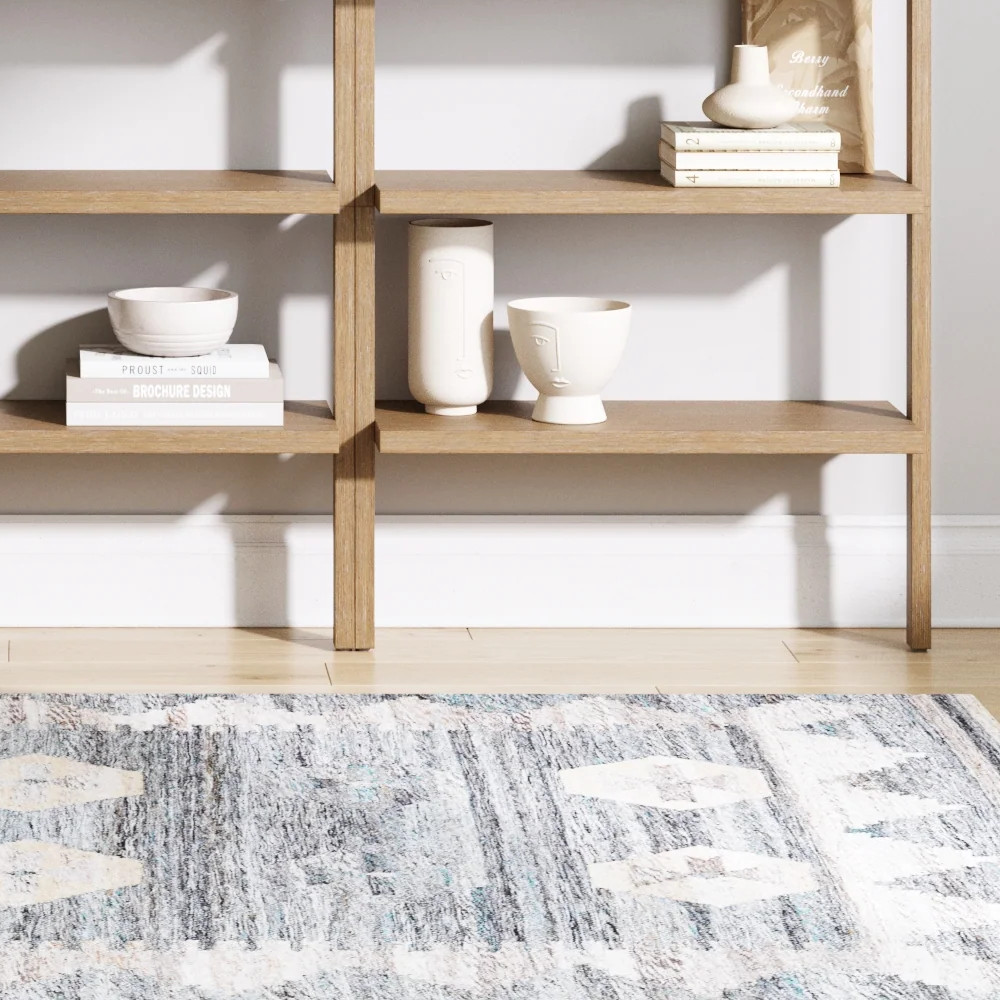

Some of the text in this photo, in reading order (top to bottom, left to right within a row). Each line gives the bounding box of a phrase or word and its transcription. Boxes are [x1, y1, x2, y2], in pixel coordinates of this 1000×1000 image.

[777, 84, 850, 98] condhand
[122, 365, 164, 375] PROUST
[190, 365, 217, 375] SQUID
[132, 383, 231, 398] BROCHURE DESIGN
